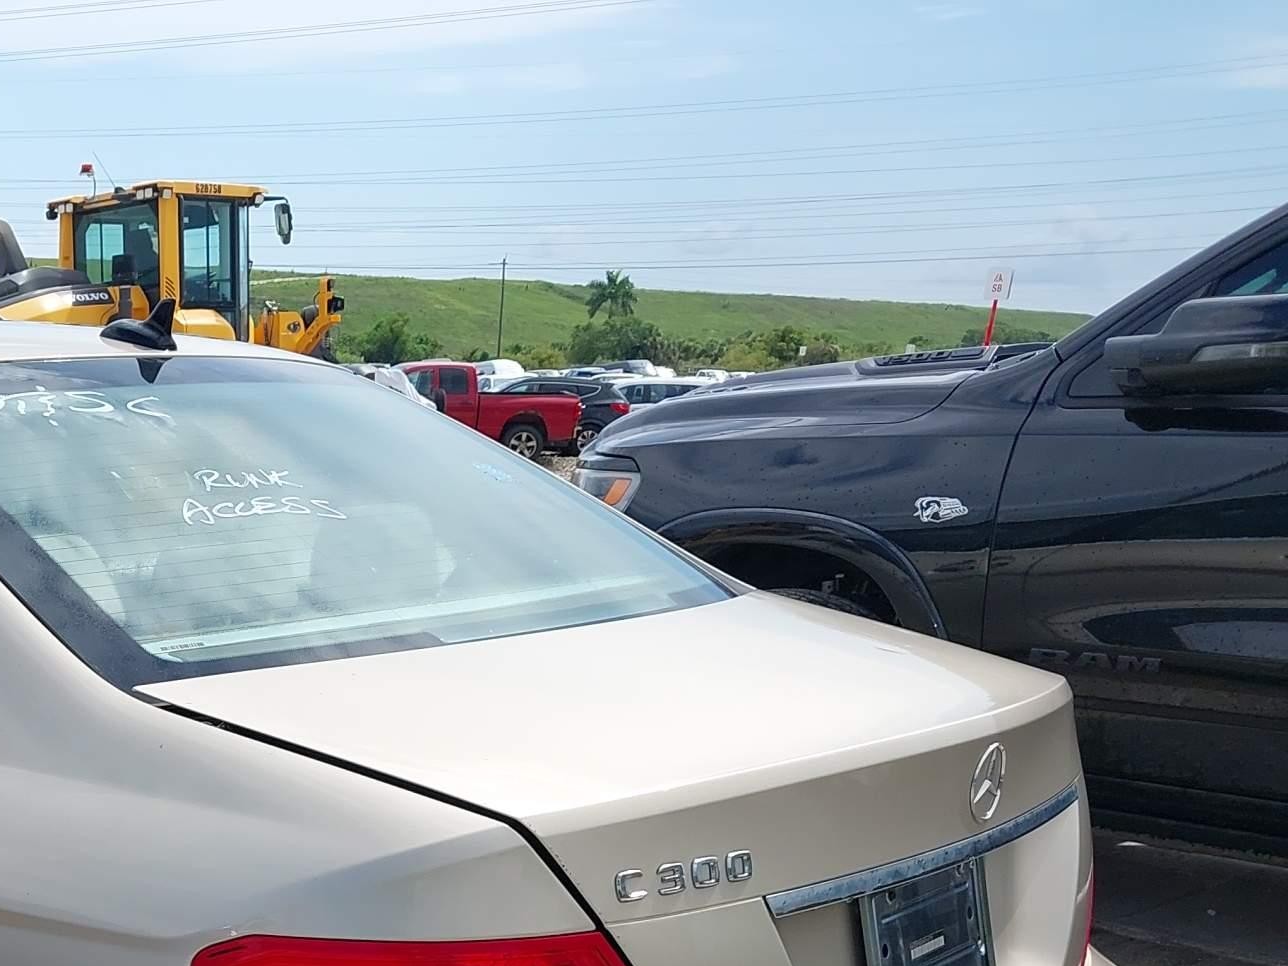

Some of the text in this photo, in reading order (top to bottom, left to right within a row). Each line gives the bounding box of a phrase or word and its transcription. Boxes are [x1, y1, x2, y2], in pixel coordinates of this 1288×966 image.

[181, 496, 348, 526] ACCESS
[1030, 648, 1160, 672] RAM
[614, 849, 753, 904] C 300
